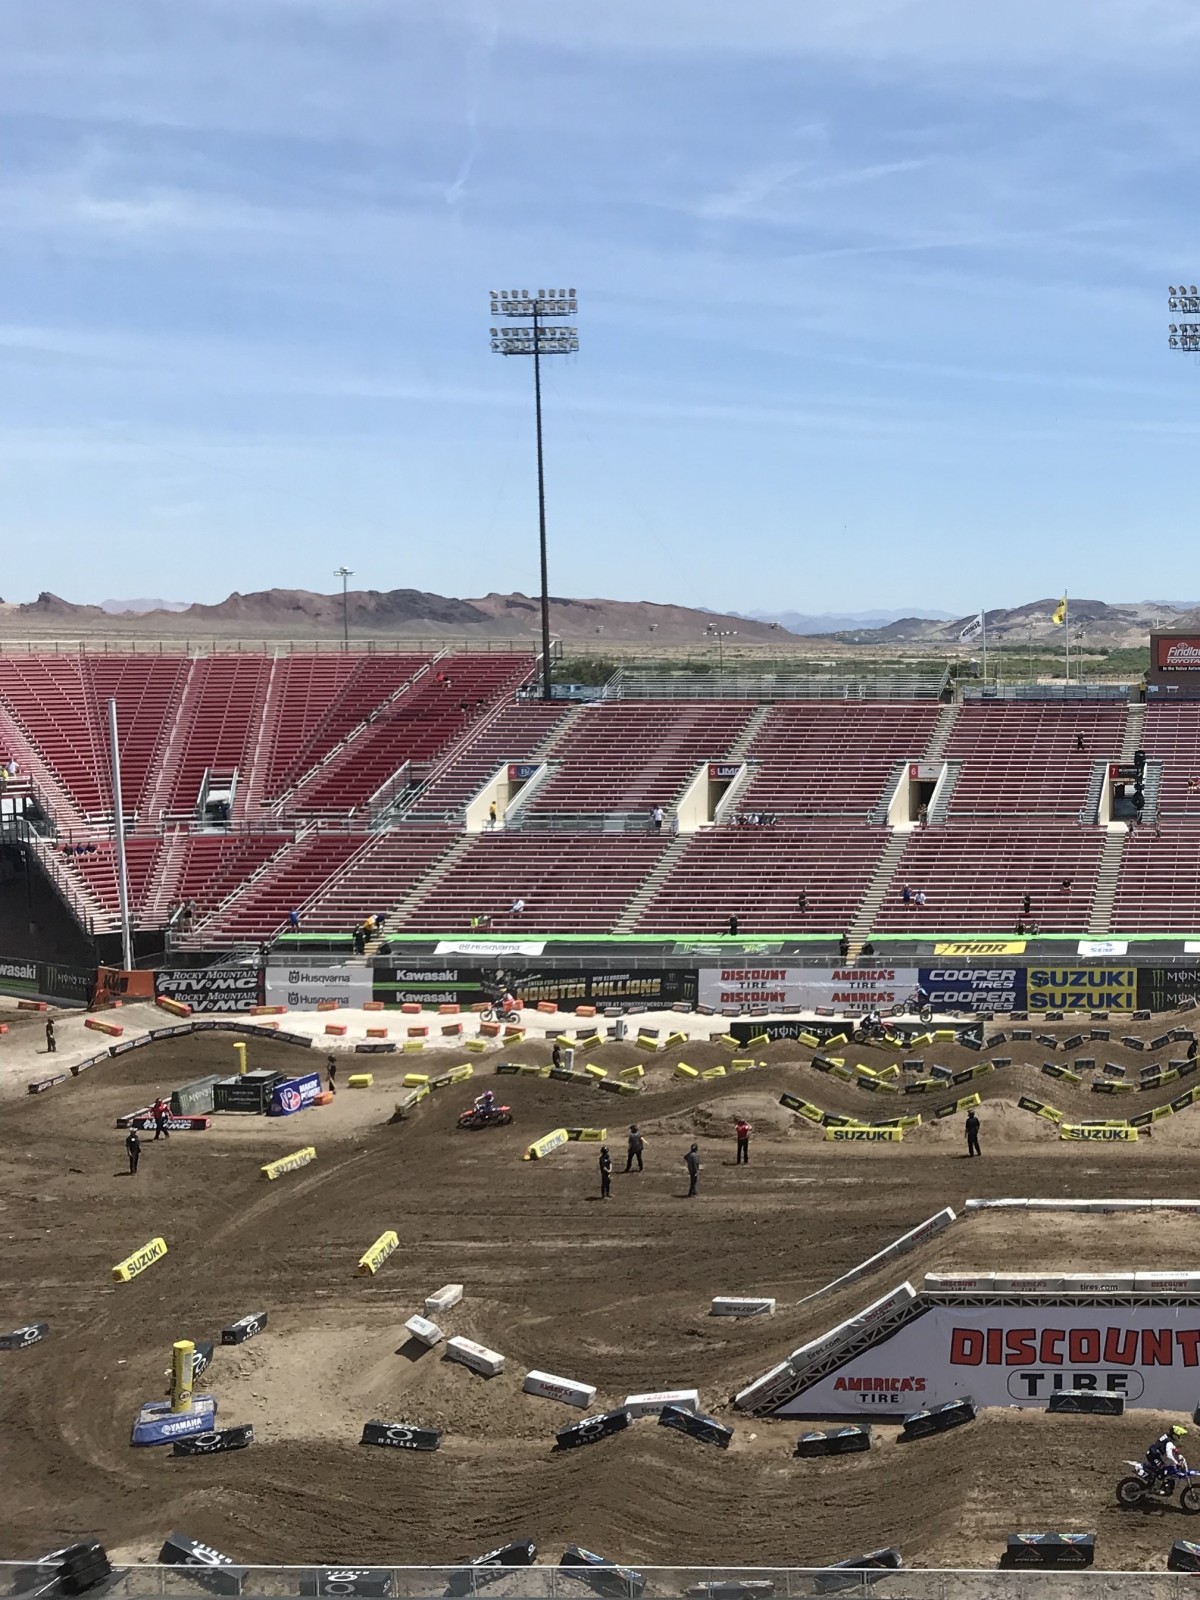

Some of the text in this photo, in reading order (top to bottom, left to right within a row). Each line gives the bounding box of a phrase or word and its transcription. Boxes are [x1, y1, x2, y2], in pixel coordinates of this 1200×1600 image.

[911, 768, 916, 776] 6
[952, 944, 1008, 954] THOR
[172, 970, 258, 980] ROCKY MOUNTAIN
[300, 973, 350, 983] Husqvarna
[396, 970, 458, 981] Kawasaki
[721, 970, 786, 981] DISCOUNT
[831, 969, 894, 981] AMERICA'S
[929, 970, 1016, 981] COOPER
[1030, 970, 1134, 987] SUZUKI
[517, 983, 586, 1002] MONSTER
[591, 978, 662, 997] MILLIONS
[971, 981, 1014, 989] TIRES
[174, 992, 258, 1000] ROCKY MOUNTAIN
[396, 992, 456, 1002] Kawasaki
[720, 992, 786, 1002] DISCOUNT
[831, 992, 894, 1002] AMERICA'S
[929, 992, 1016, 1002] COOPER
[1030, 993, 1134, 1008] SUZUKI
[834, 1131, 892, 1140] SUZUKI
[1070, 1129, 1128, 1140] SUZUKI
[540, 1134, 567, 1154] SUZUKI
[276, 1150, 316, 1174] SUZUKI
[128, 1243, 162, 1275] SUZUKI
[372, 1238, 397, 1269] SUZUKI
[864, 1300, 896, 1323] DISCOUNT
[807, 1337, 841, 1360] tires.com
[833, 1375, 926, 1392] AMERICA'S
[1020, 1374, 1128, 1399] TIRE
[860, 1393, 899, 1403] TIRE
[170, 1417, 202, 1431] YAMAHA
[576, 1428, 613, 1445] OAKLEY
[378, 1437, 418, 1448] OAKLEY
